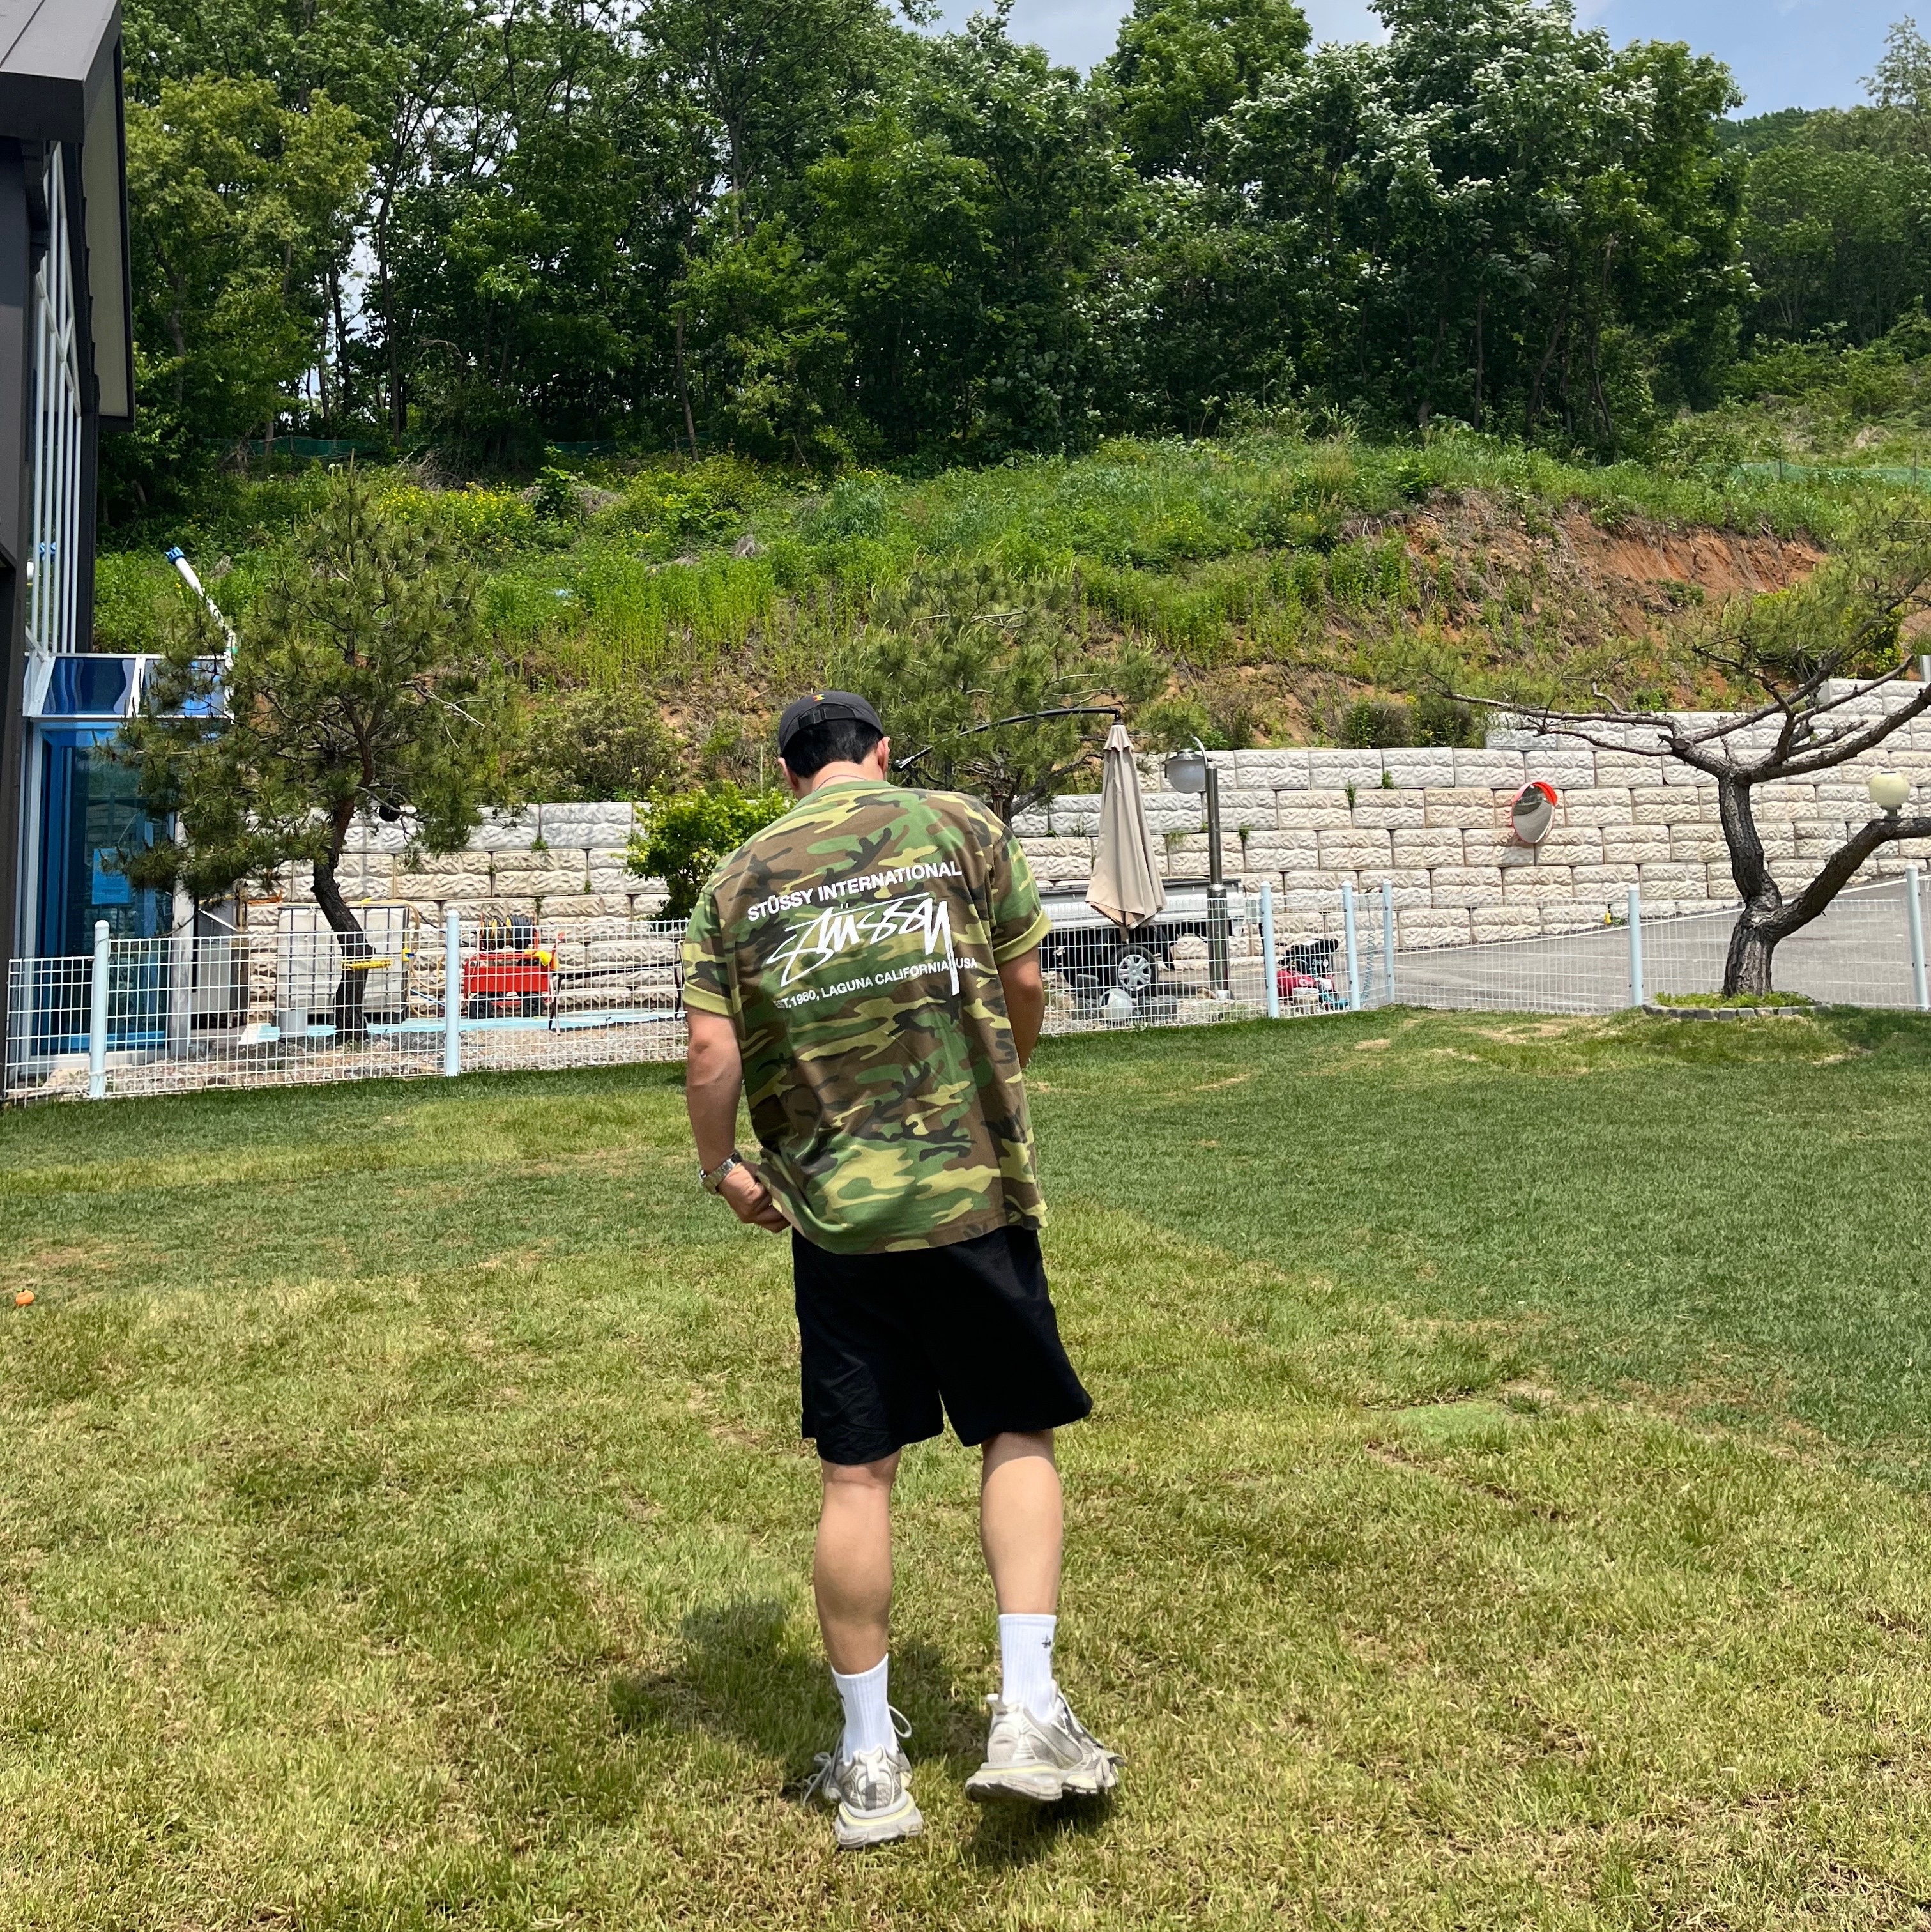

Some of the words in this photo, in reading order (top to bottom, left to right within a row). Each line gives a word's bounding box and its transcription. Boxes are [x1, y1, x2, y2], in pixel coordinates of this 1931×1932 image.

[747, 888, 813, 921] STÜSSY
[818, 861, 962, 901] INTERNATIONAL
[821, 976, 874, 998] LAGUNA
[874, 960, 950, 985] CALIFORNIA
[955, 957, 978, 969] USA
